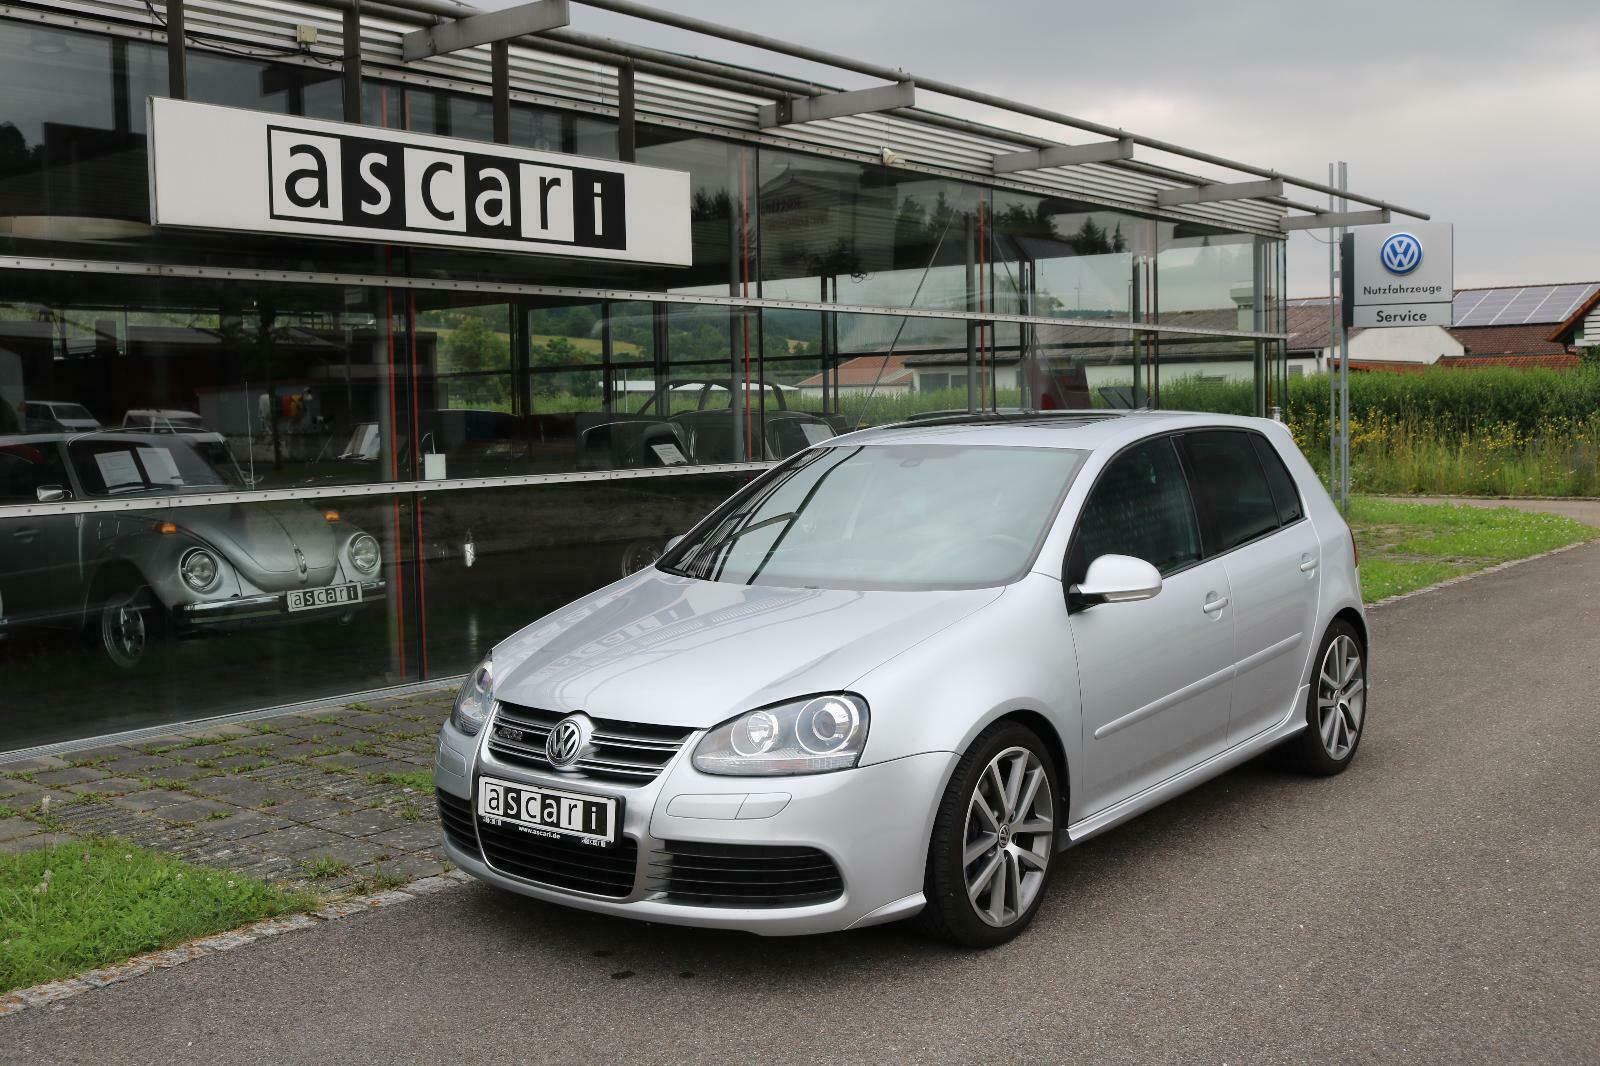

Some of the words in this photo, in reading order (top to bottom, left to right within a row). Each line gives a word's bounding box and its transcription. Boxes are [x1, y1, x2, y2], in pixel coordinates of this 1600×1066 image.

[284, 143, 603, 236] ascari
[1363, 284, 1442, 296] Nutzfahrzeuge
[1376, 310, 1427, 323] Service
[294, 588, 355, 606] ascari
[489, 788, 597, 830] ascari
[518, 826, 561, 840] www.ascari.de
